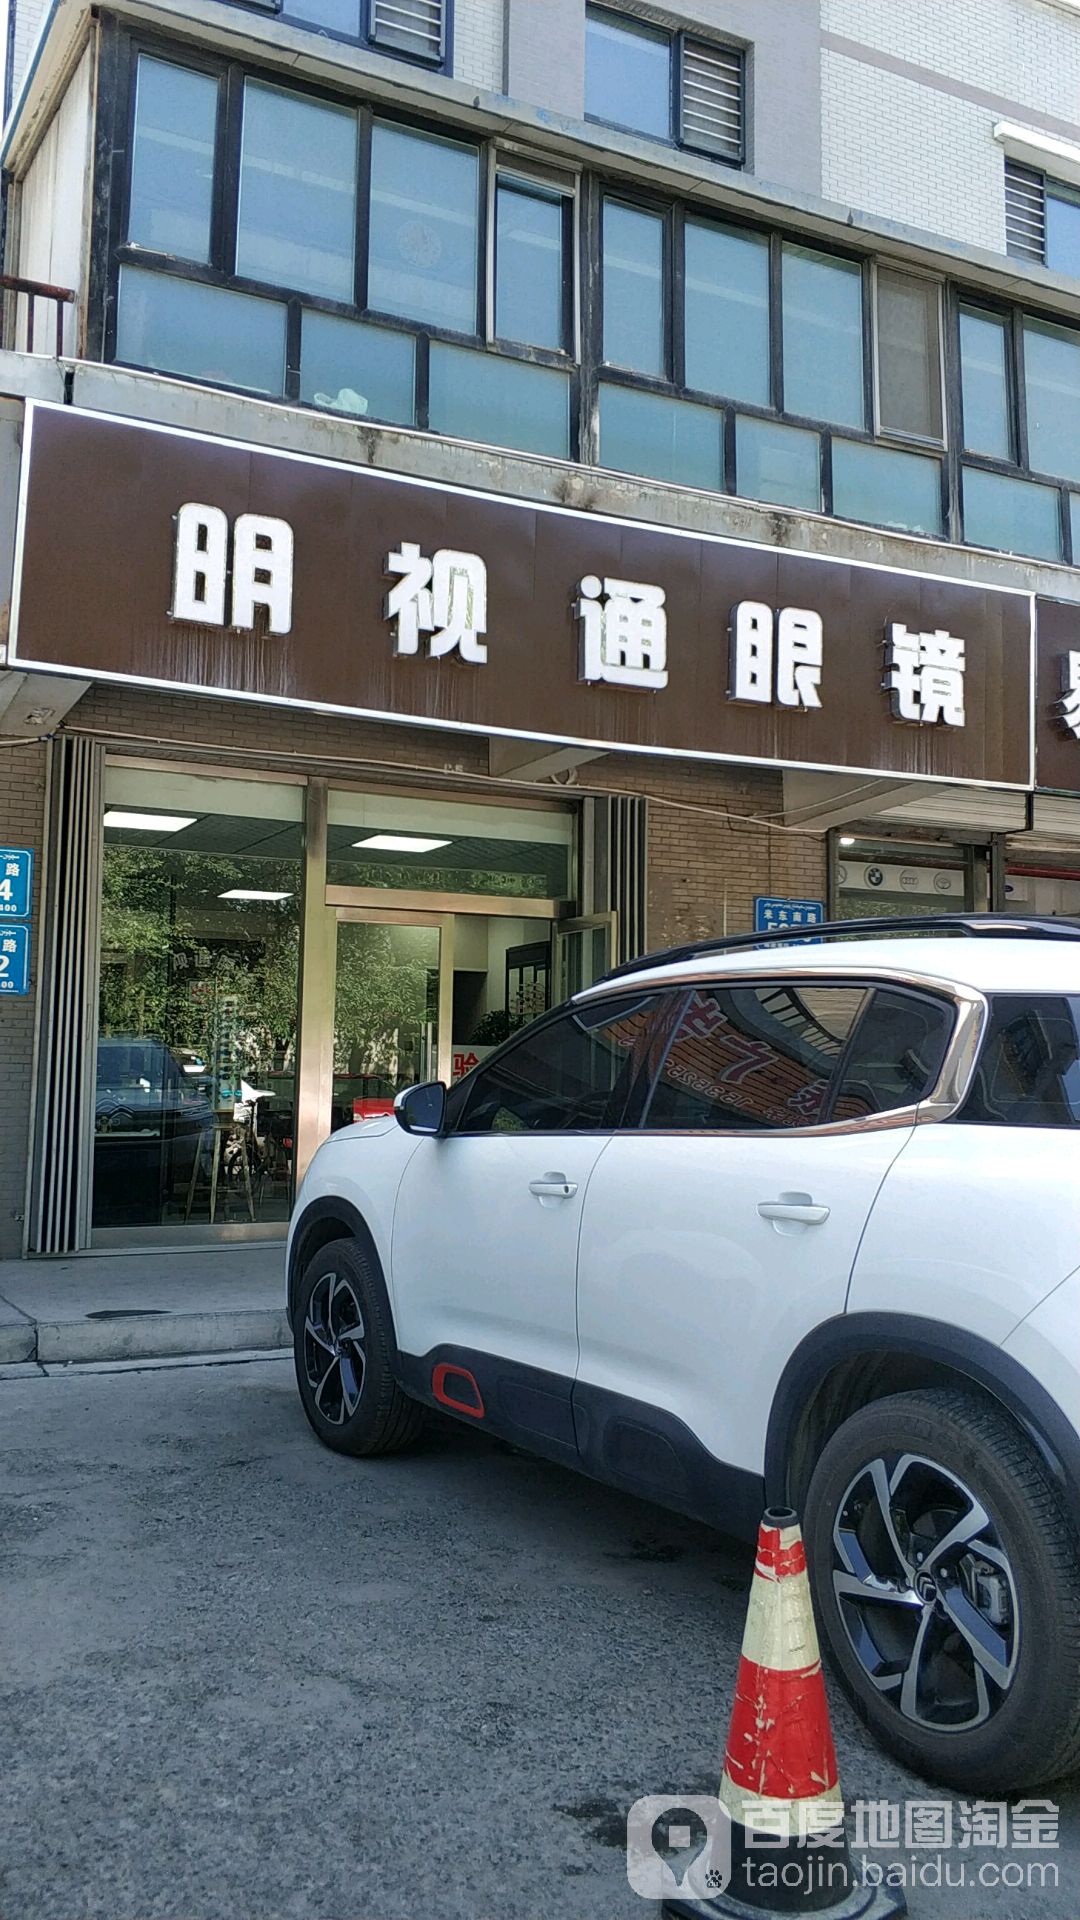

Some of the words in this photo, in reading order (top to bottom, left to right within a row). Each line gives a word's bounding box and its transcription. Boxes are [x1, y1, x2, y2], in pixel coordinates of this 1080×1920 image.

[171, 502, 966, 728] 明视通眼镜
[5, 863, 20, 876] 路
[2, 939, 17, 952] 路
